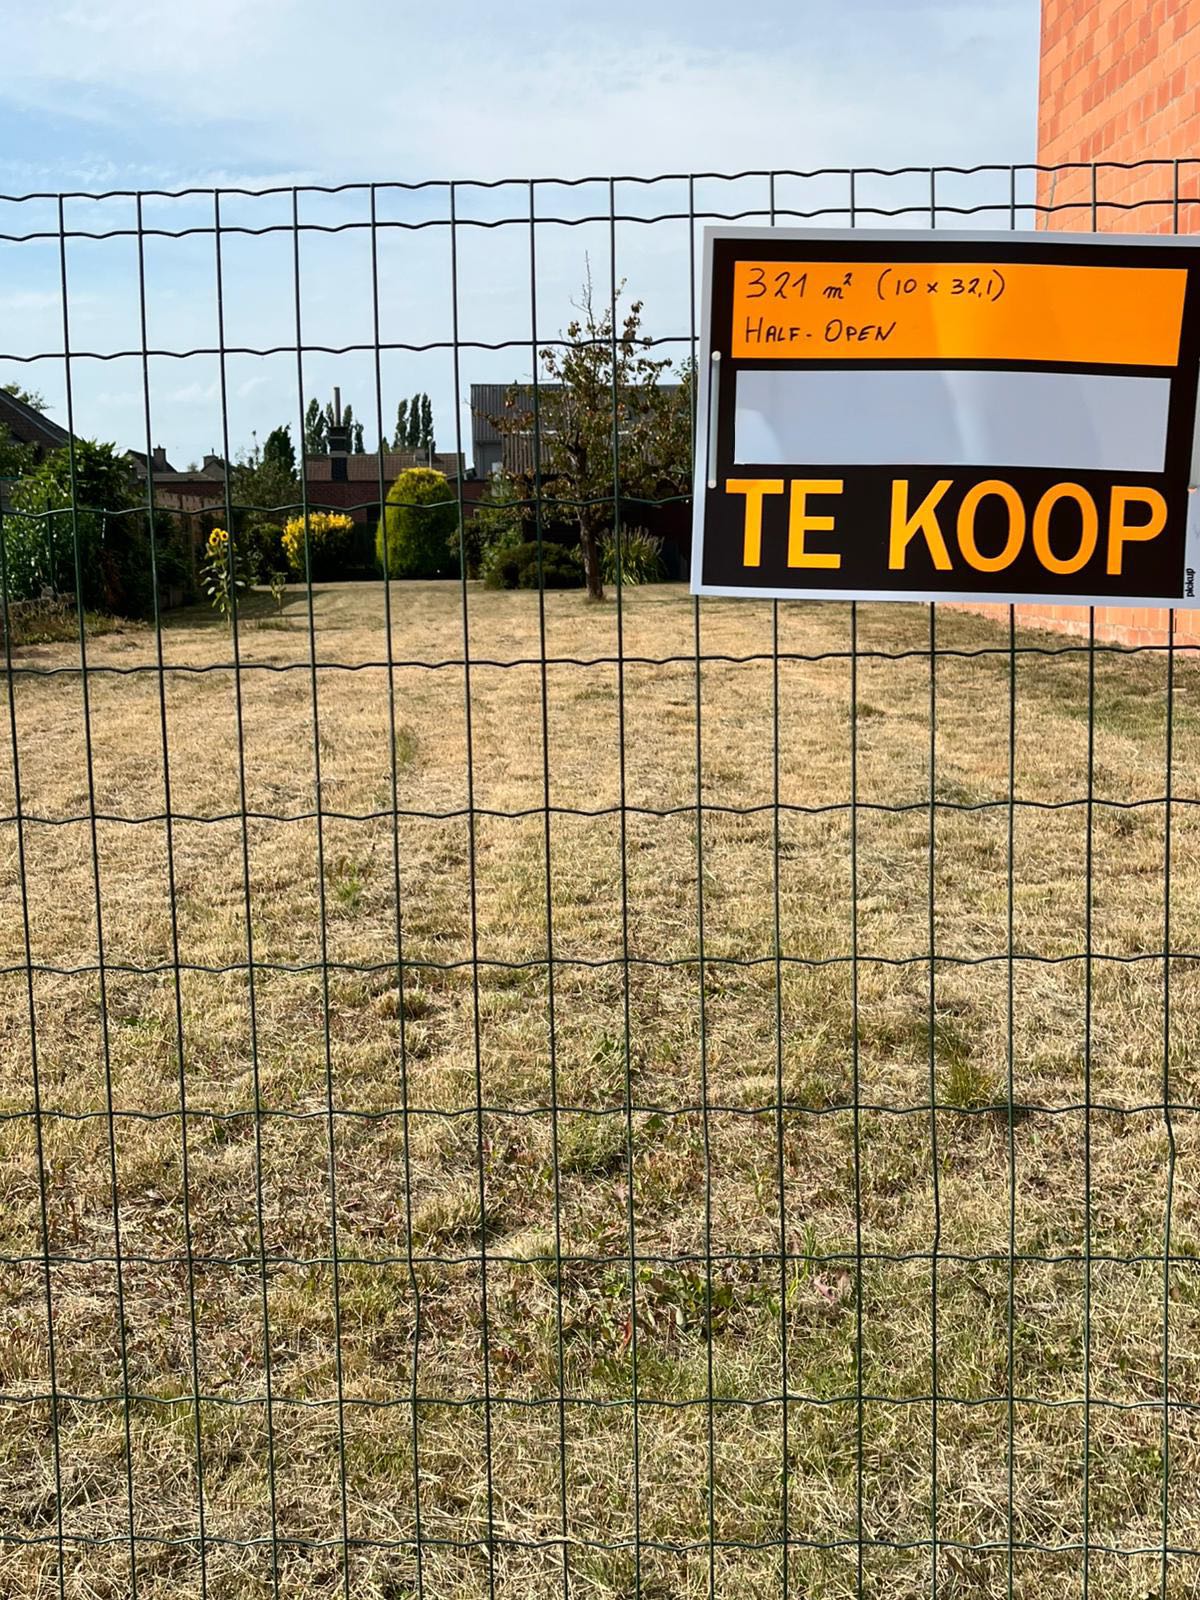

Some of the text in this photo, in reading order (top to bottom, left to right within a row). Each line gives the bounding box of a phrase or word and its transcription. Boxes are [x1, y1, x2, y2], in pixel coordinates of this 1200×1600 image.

[745, 267, 808, 299] 321
[877, 268, 917, 301] (10
[950, 268, 1006, 302] 32,1)
[725, 478, 1168, 576] TE KOOP
[1184, 567, 1196, 598] pickup
